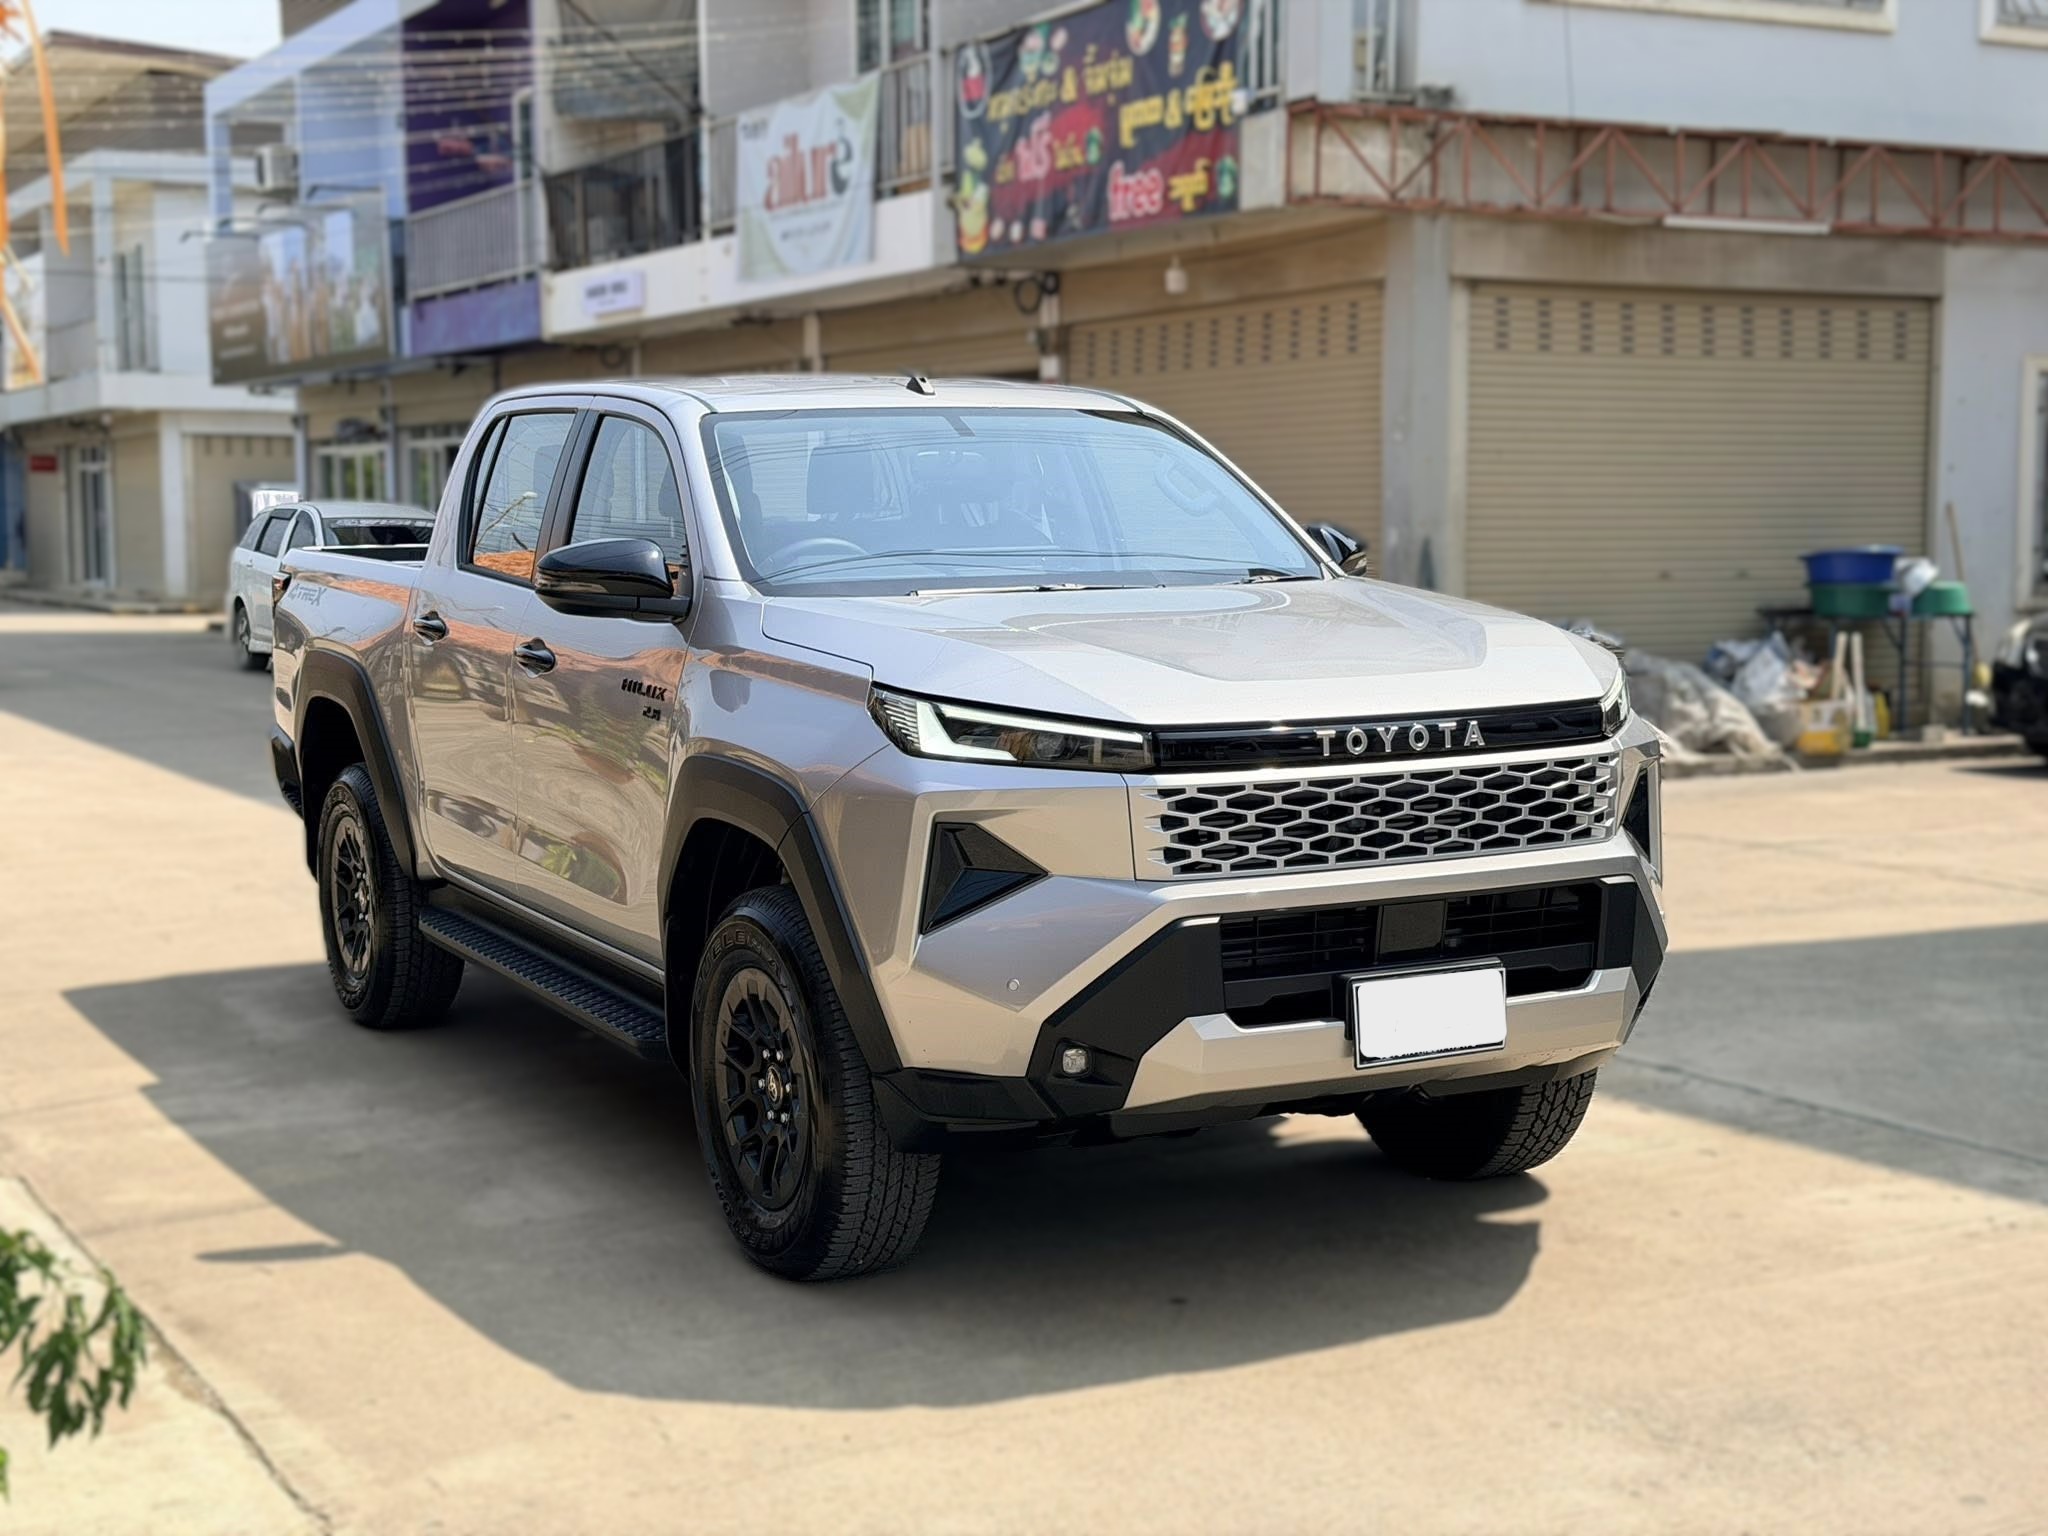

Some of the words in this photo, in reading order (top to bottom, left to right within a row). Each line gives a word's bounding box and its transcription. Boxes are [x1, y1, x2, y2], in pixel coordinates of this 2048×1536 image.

[1108, 160, 1164, 222] free
[621, 678, 667, 701] HILUX
[1314, 719, 1486, 757] TOYOTA
